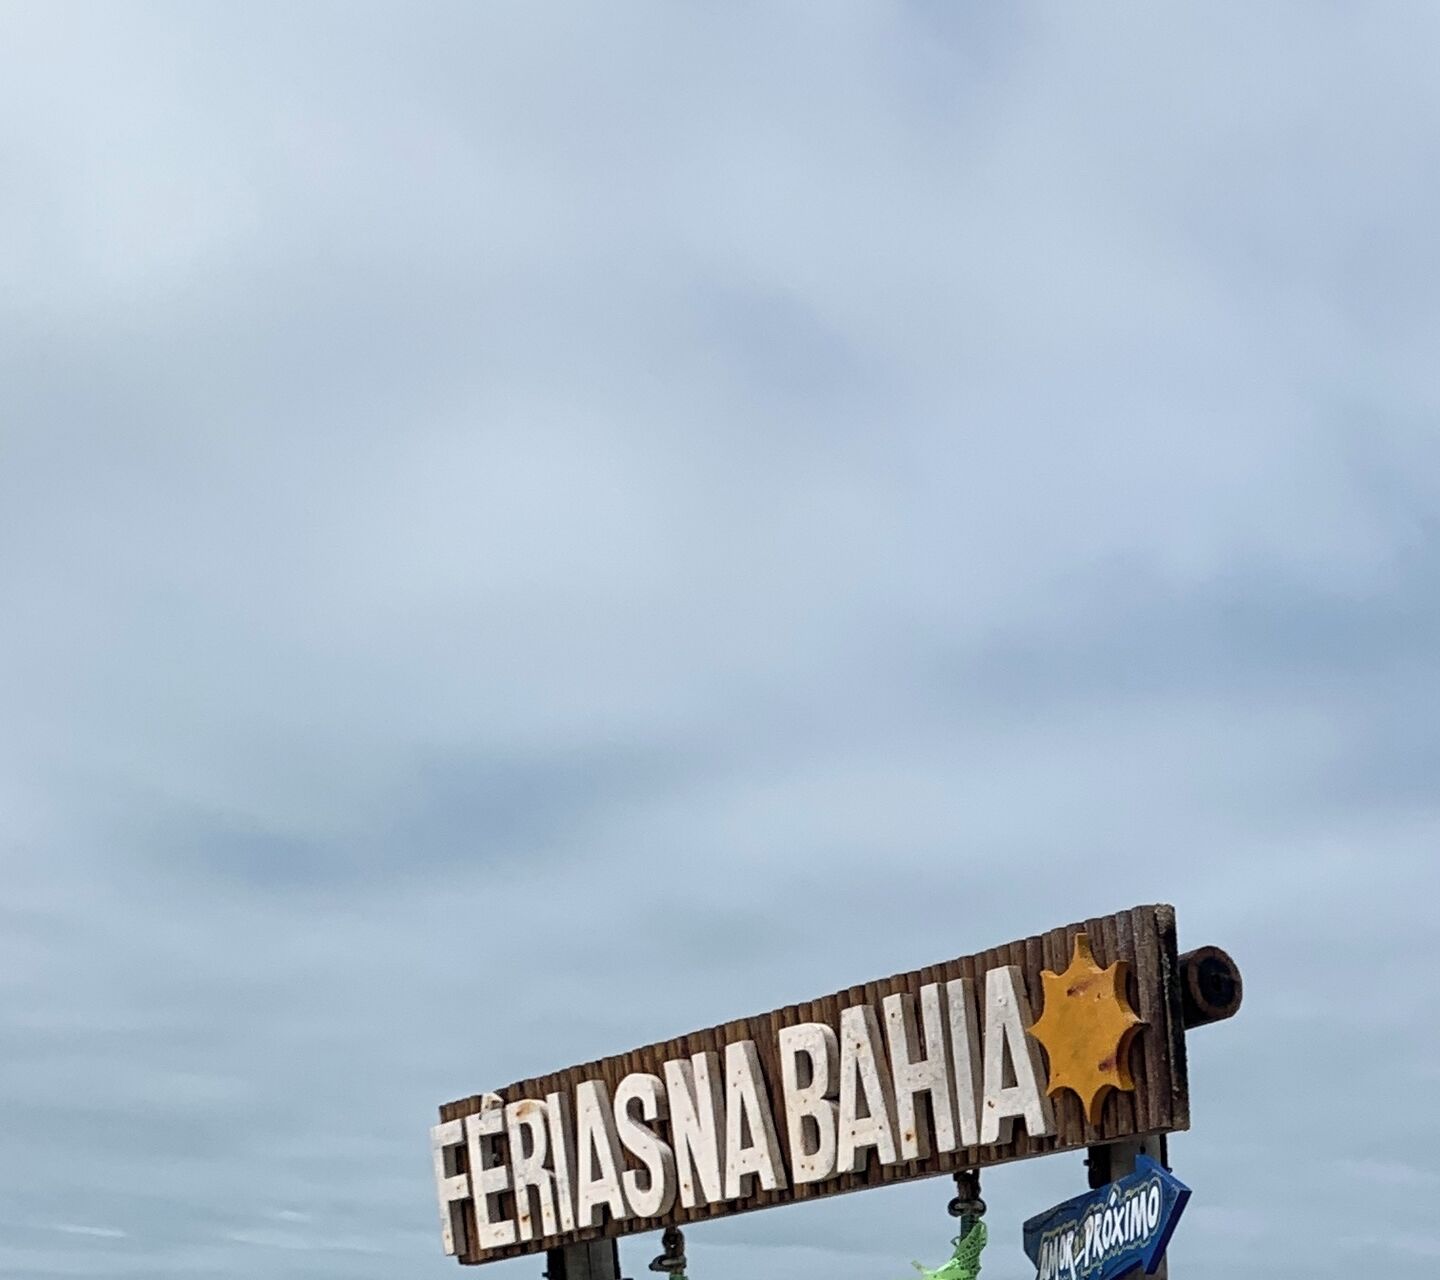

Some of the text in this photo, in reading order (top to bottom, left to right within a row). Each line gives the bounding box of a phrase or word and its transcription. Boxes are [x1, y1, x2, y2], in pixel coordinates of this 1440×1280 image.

[664, 1040, 788, 1207] NA
[779, 965, 1052, 1185] BAHIA
[1083, 1184, 1161, 1268] PRÓXIMO
